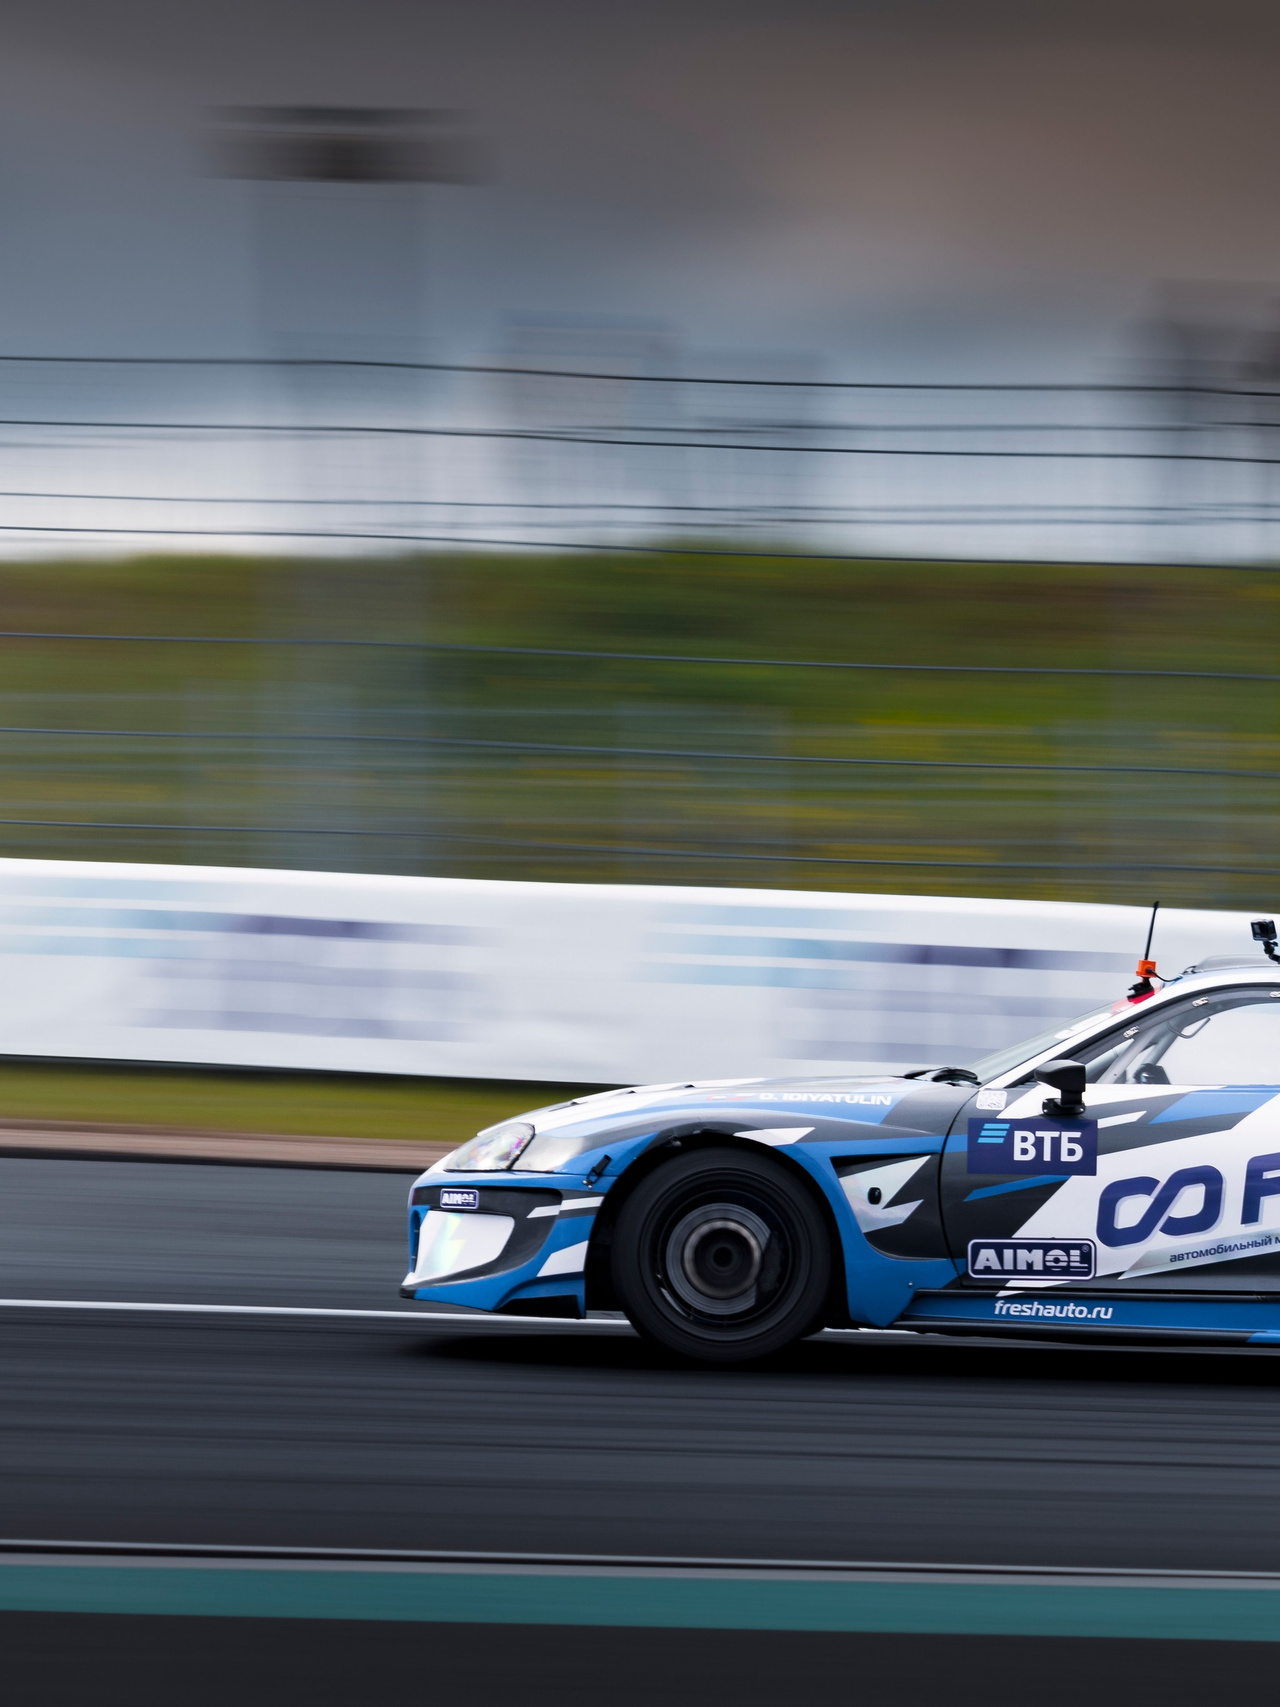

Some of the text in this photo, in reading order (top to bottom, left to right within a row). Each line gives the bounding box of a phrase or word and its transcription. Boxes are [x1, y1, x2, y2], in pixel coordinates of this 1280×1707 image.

[783, 1093, 891, 1105] IDIYATULIN
[1012, 1130, 1083, 1162] ВТБ
[1169, 1236, 1273, 1263] автомобильный
[994, 1299, 1113, 1320] freshauto.ru
